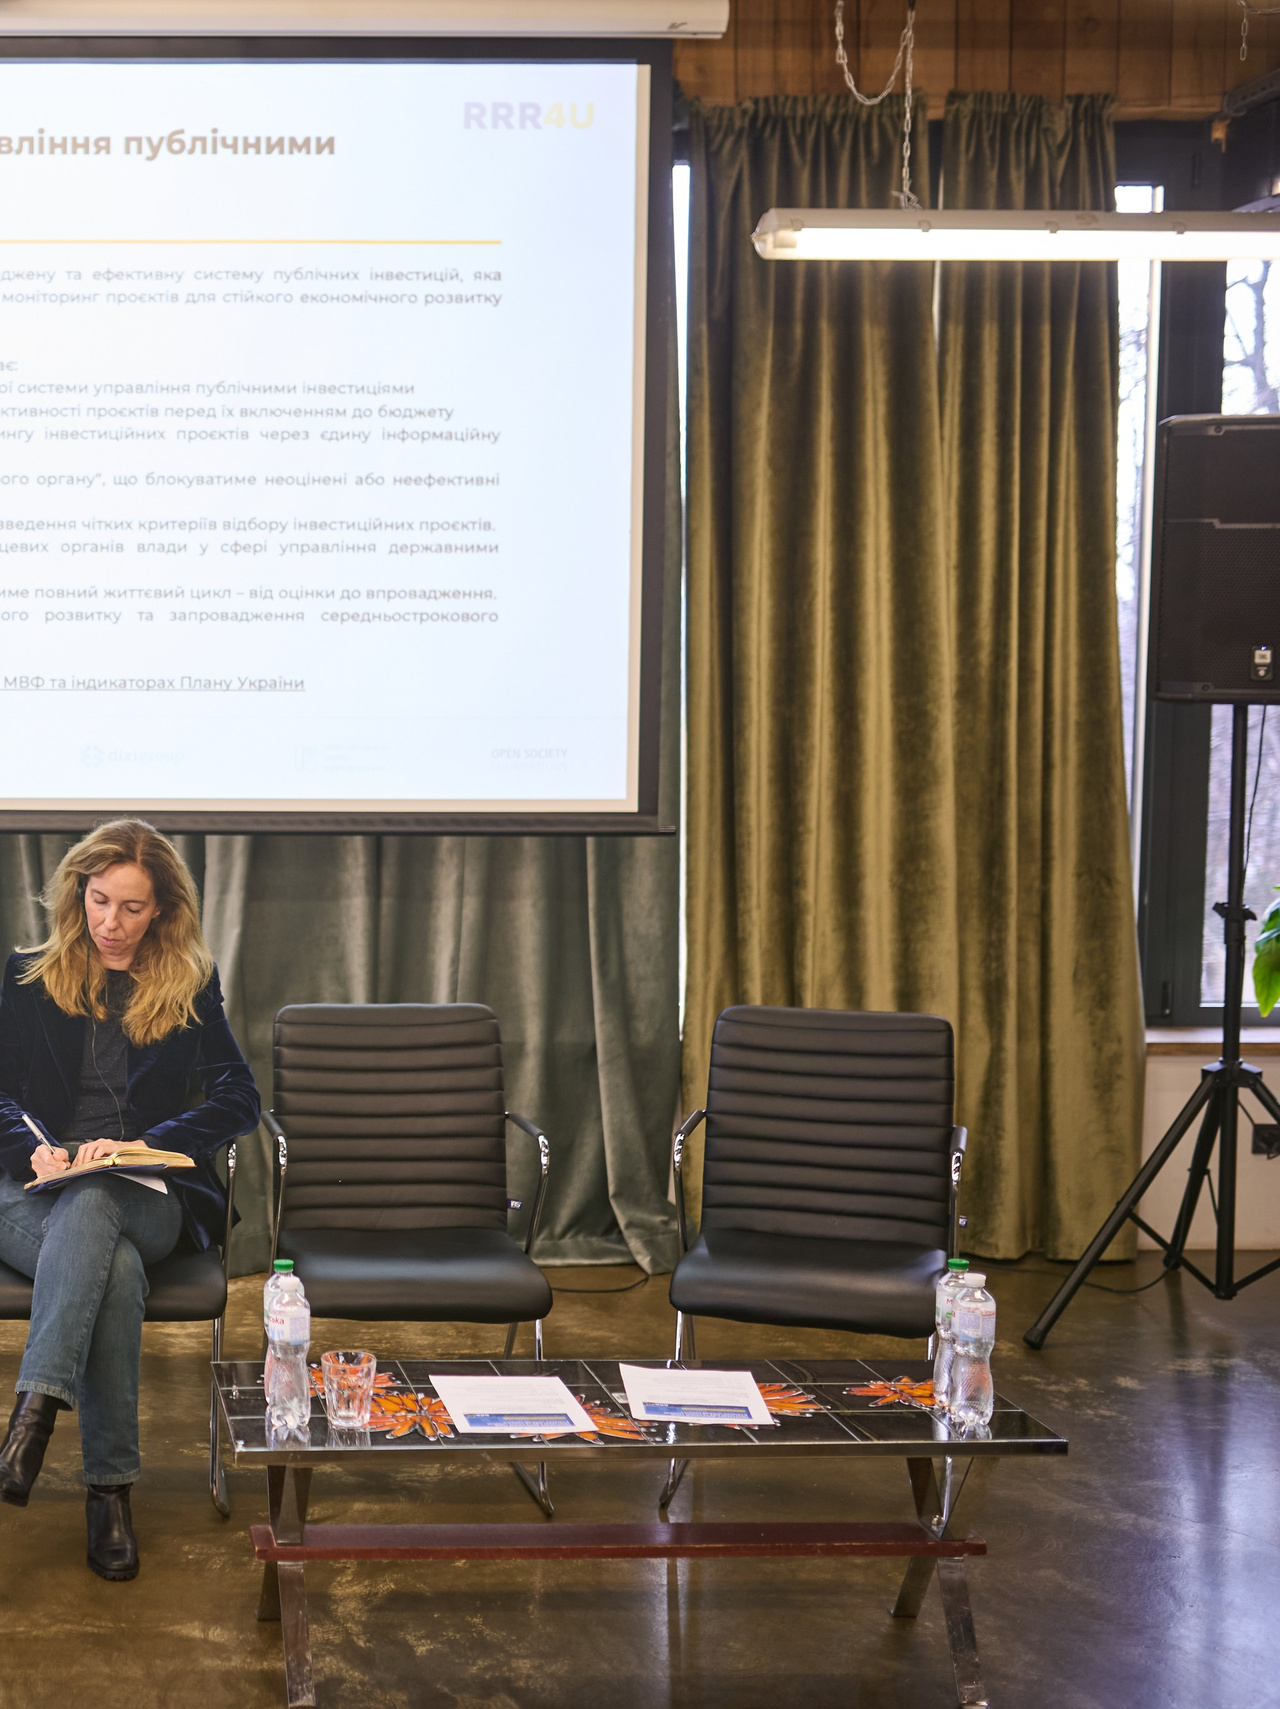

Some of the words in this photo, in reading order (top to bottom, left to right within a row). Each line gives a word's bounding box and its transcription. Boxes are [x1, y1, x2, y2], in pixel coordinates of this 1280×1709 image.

[463, 101, 596, 131] RRR4U
[123, 127, 336, 162] публічними
[92, 267, 185, 284] ефективну
[193, 270, 264, 283] систему
[273, 267, 360, 284] публічних
[370, 268, 463, 283] інвестицій,
[473, 271, 502, 281] яка
[2, 290, 100, 306] моніторинг
[106, 290, 179, 306] проєктів
[184, 293, 217, 304] для
[222, 290, 293, 303] стійкого
[300, 290, 418, 304] економічного
[424, 293, 503, 307] розвитку
[17, 384, 88, 394] системи
[93, 381, 191, 397] управління
[196, 380, 297, 397] публічними
[302, 381, 415, 396] інвестиціями
[86, 404, 159, 420] проєктів
[164, 407, 217, 420] перед
[221, 404, 235, 418] їх
[239, 408, 347, 418] включенням
[351, 408, 373, 419] до
[378, 404, 454, 421] бюджету
[45, 426, 166, 441] інвестиційних
[177, 427, 250, 443] проєктів
[260, 430, 310, 443] через
[320, 430, 371, 444] єдину
[382, 427, 501, 444] інформаційну
[113, 475, 138, 487] що
[145, 471, 257, 488] блокуватиме
[265, 472, 347, 487] неоцінені
[355, 472, 385, 486] або
[393, 473, 500, 489] неефективні
[81, 517, 133, 530] чітких
[138, 517, 217, 533] критеріїв
[222, 517, 289, 534] відбору
[293, 517, 415, 532] інвестиційних
[419, 518, 496, 534] проєктів.
[61, 539, 124, 555] органів
[137, 543, 187, 554] влади
[220, 540, 267, 556] сфері
[279, 540, 376, 556] управління
[388, 543, 499, 556] державними
[35, 586, 98, 598] повний
[103, 586, 185, 599] життєвий
[190, 589, 231, 600] цикл
[249, 585, 274, 600] від
[278, 586, 335, 600] оцінки
[339, 589, 361, 601] до
[366, 589, 497, 602] впровадження.
[45, 611, 122, 624] розвитку
[169, 611, 305, 624] запровадження
[320, 612, 499, 625] середньострокового
[4, 676, 45, 690] МВФ
[72, 675, 175, 690] індикаторах
[181, 676, 233, 690] Плану
[237, 676, 304, 690] України
[491, 748, 521, 759] OPEN
[524, 748, 568, 759] SOCIETY
